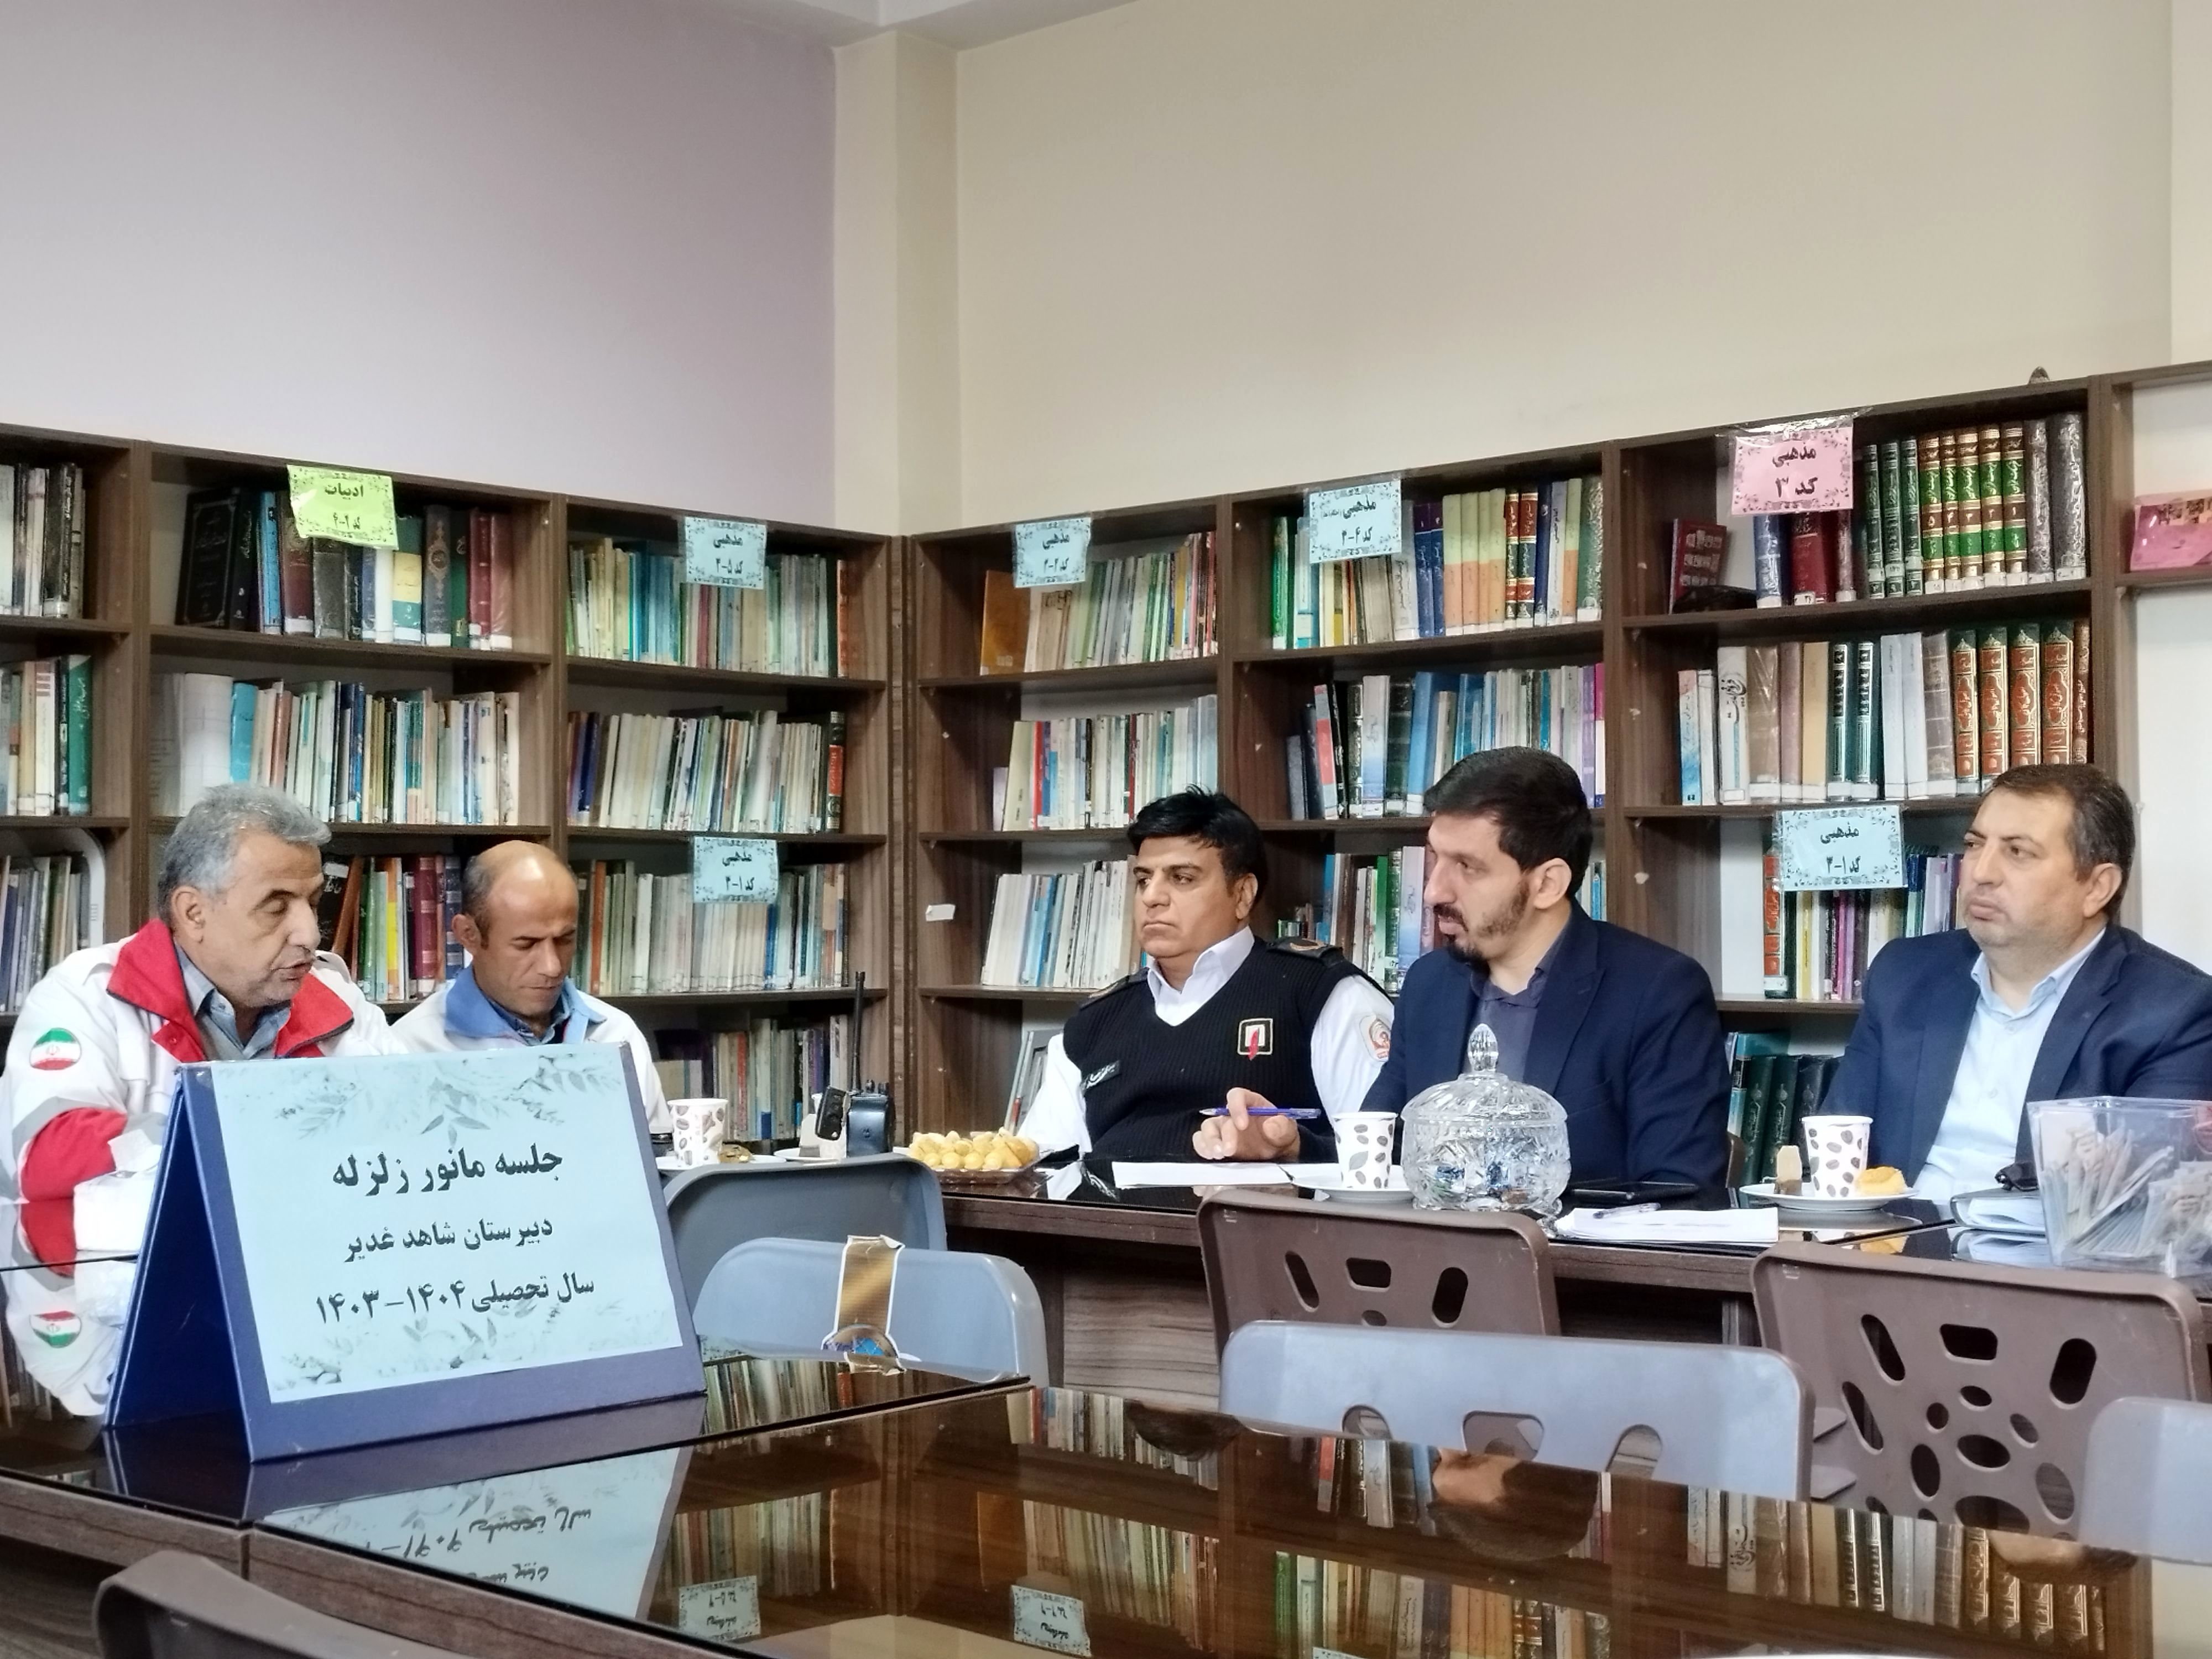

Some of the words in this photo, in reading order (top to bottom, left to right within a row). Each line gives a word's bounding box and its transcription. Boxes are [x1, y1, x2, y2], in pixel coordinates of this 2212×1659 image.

[1772, 442, 1817, 468] مذهبی
[325, 482, 364, 500] ادبیات
[1795, 477, 1818, 495] کد
[1343, 494, 1377, 519] مذهبی
[352, 516, 361, 530] کد
[713, 530, 743, 549] مذهبی
[1042, 529, 1070, 550] مذهبی
[1363, 526, 1373, 542] کد
[734, 560, 743, 574] کد
[1060, 557, 1069, 571] کد
[1820, 822, 1859, 844] مذهبی
[722, 847, 752, 867] مذهبی
[1850, 855, 1861, 873] کد
[745, 877, 755, 891] کد
[421, 1147, 485, 1193] مانور
[495, 1143, 562, 1182] جلسه
[333, 1152, 409, 1196] زلزله
[345, 1227, 394, 1263] غدیر
[403, 1222, 455, 1249] شاهد
[464, 1218, 552, 1251] دبیرستان
[472, 1276, 549, 1313] تحصیلی
[557, 1272, 594, 1303] سال
